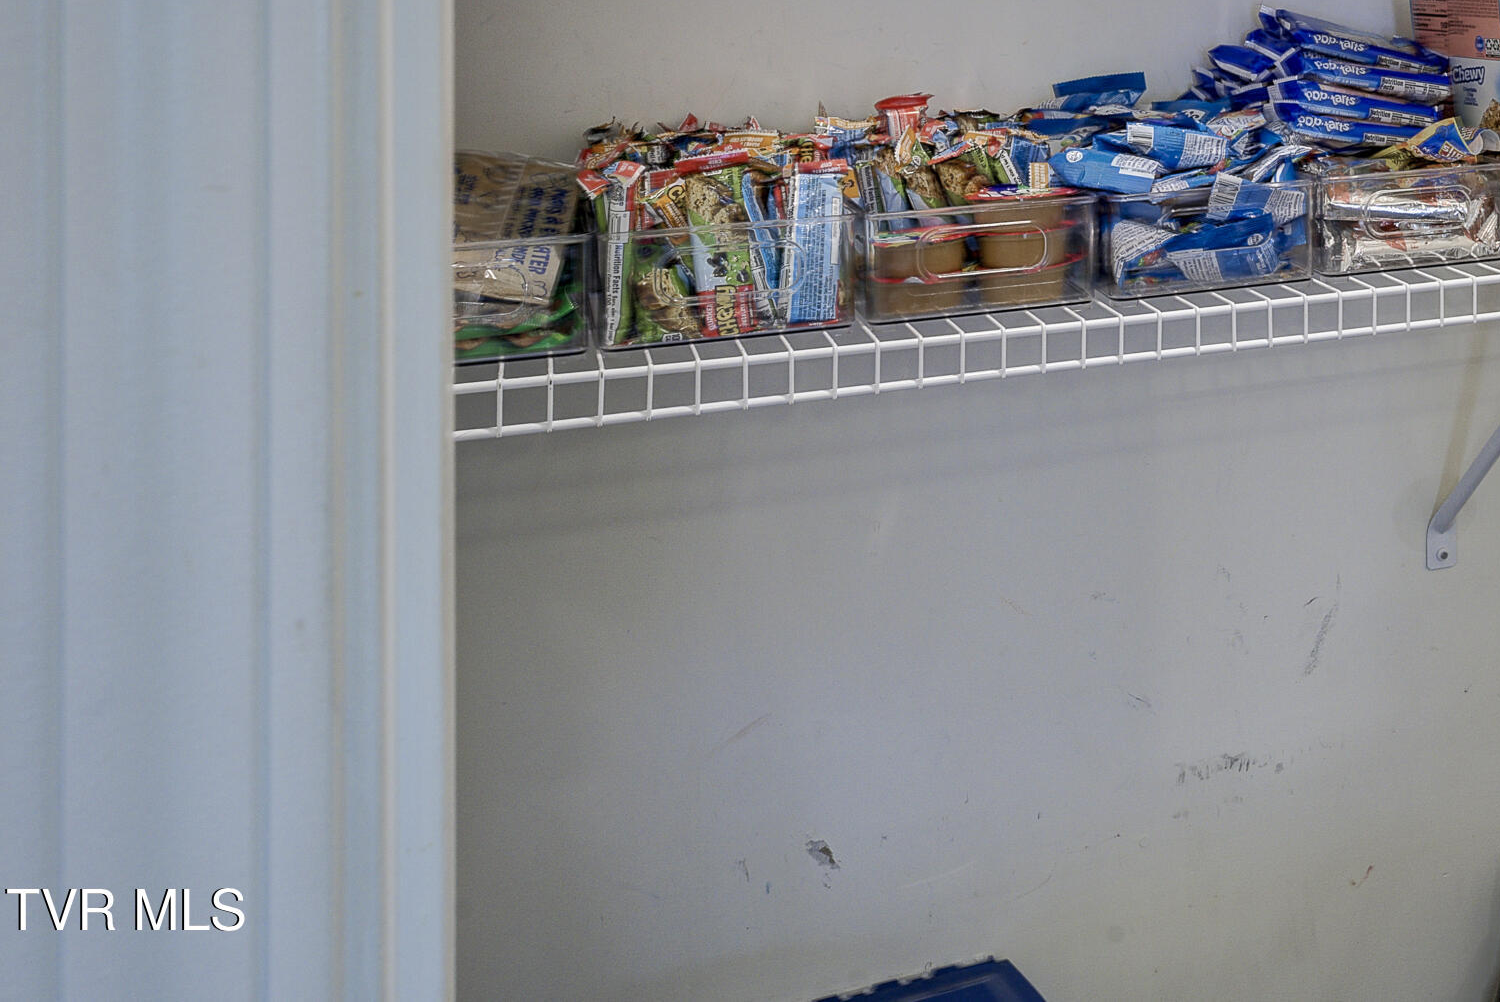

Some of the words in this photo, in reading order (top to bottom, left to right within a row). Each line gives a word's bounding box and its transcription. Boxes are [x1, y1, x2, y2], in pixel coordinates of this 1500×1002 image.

[1380, 76, 1404, 88] Nutrition
[1451, 64, 1486, 85] Chewy
[614, 244, 624, 276] Nutrition
